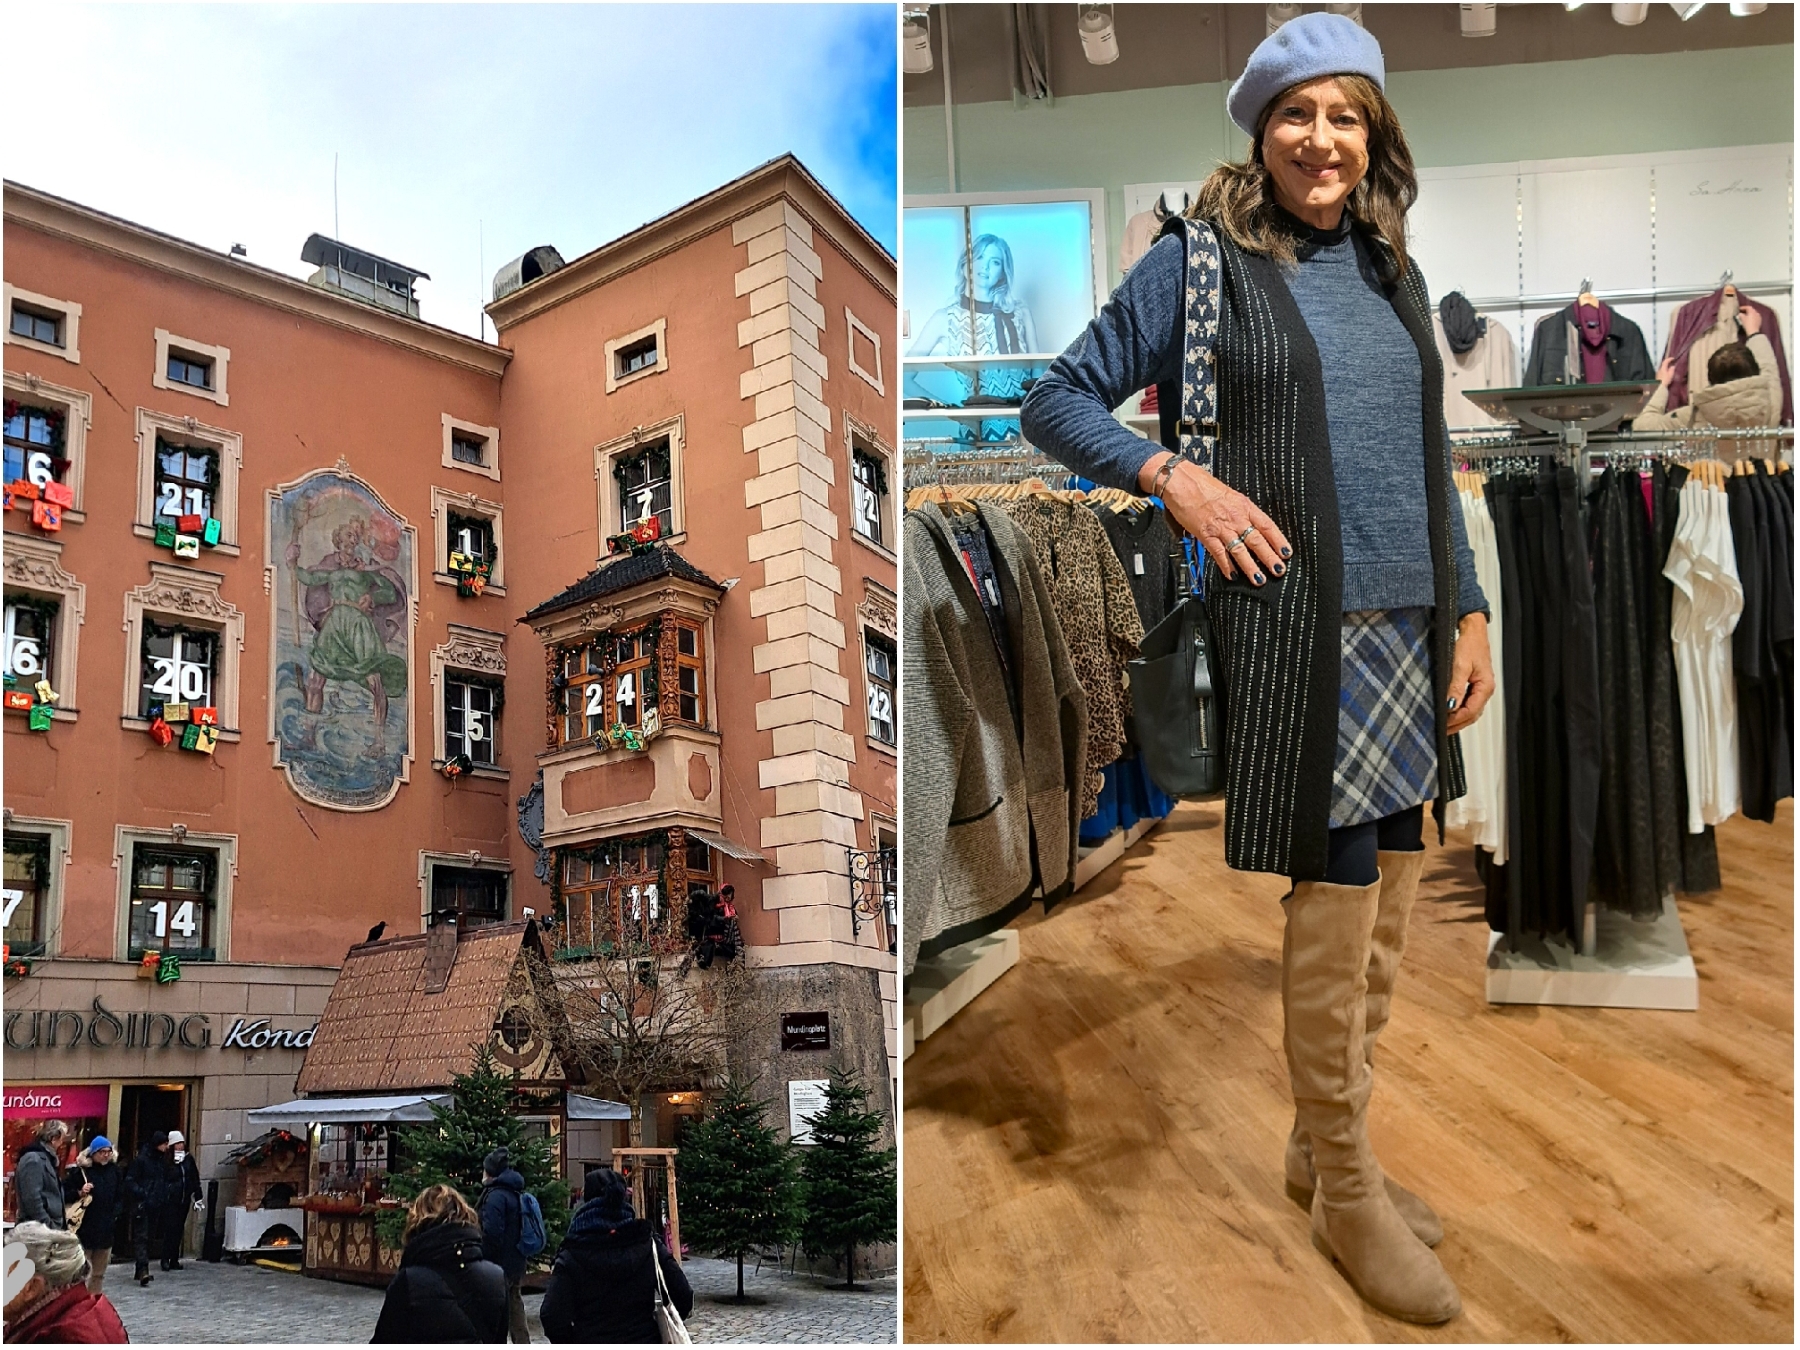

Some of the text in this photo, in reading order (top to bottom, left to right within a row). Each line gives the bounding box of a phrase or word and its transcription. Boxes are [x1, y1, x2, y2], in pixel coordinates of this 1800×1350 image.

[27, 452, 50, 489] 6
[161, 482, 204, 523] 21
[152, 659, 203, 700] 20
[586, 673, 636, 716] 24
[868, 684, 891, 724] 22
[467, 710, 484, 742] 5
[149, 900, 196, 938] 14
[627, 883, 659, 921] 11
[223, 1018, 318, 1050] Kond
